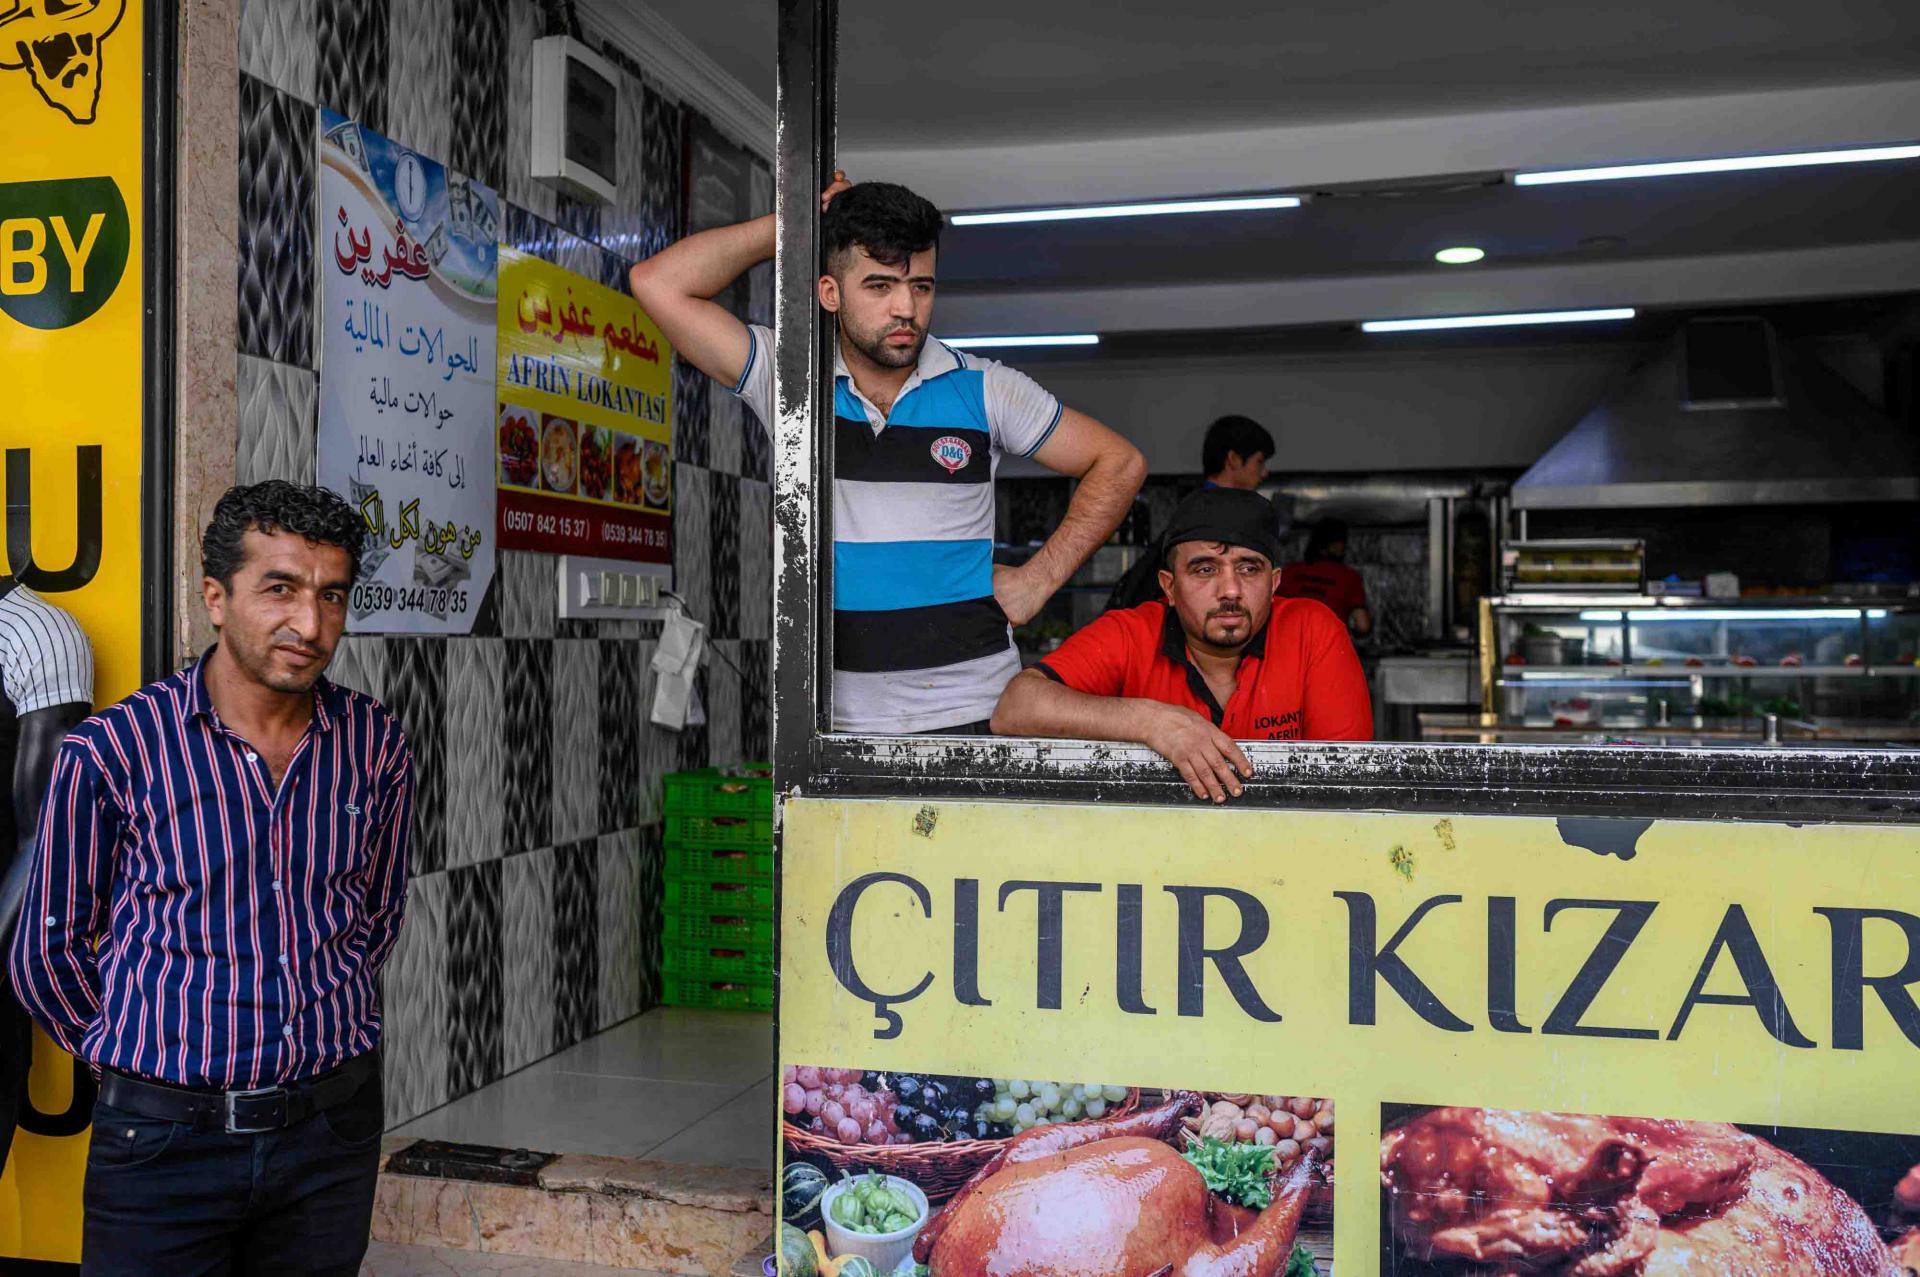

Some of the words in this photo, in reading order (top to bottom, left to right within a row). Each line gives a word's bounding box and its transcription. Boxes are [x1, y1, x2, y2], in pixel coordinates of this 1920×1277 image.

[335, 205, 430, 289] عفرين
[344, 299, 390, 352] المالية
[518, 286, 595, 344] عفرين
[399, 325, 478, 381] للحوالات
[603, 312, 659, 368] مطعم
[370, 377, 399, 414] مالية
[404, 391, 454, 429] حوالات
[357, 434, 385, 480] العالم
[391, 441, 417, 473] أنحاء
[423, 448, 448, 477] كافة
[448, 453, 465, 489] إلى
[390, 498, 420, 549] لكل
[461, 525, 481, 559] من
[537, 513, 556, 535] 842
[560, 517, 571, 536] 15
[628, 525, 643, 545] 344
[644, 529, 654, 547] 78
[353, 585, 393, 612] 0539
[398, 587, 425, 613] 344
[430, 589, 447, 615] 78
[451, 590, 467, 614] 35
[826, 871, 1283, 1040] ÇITIR
